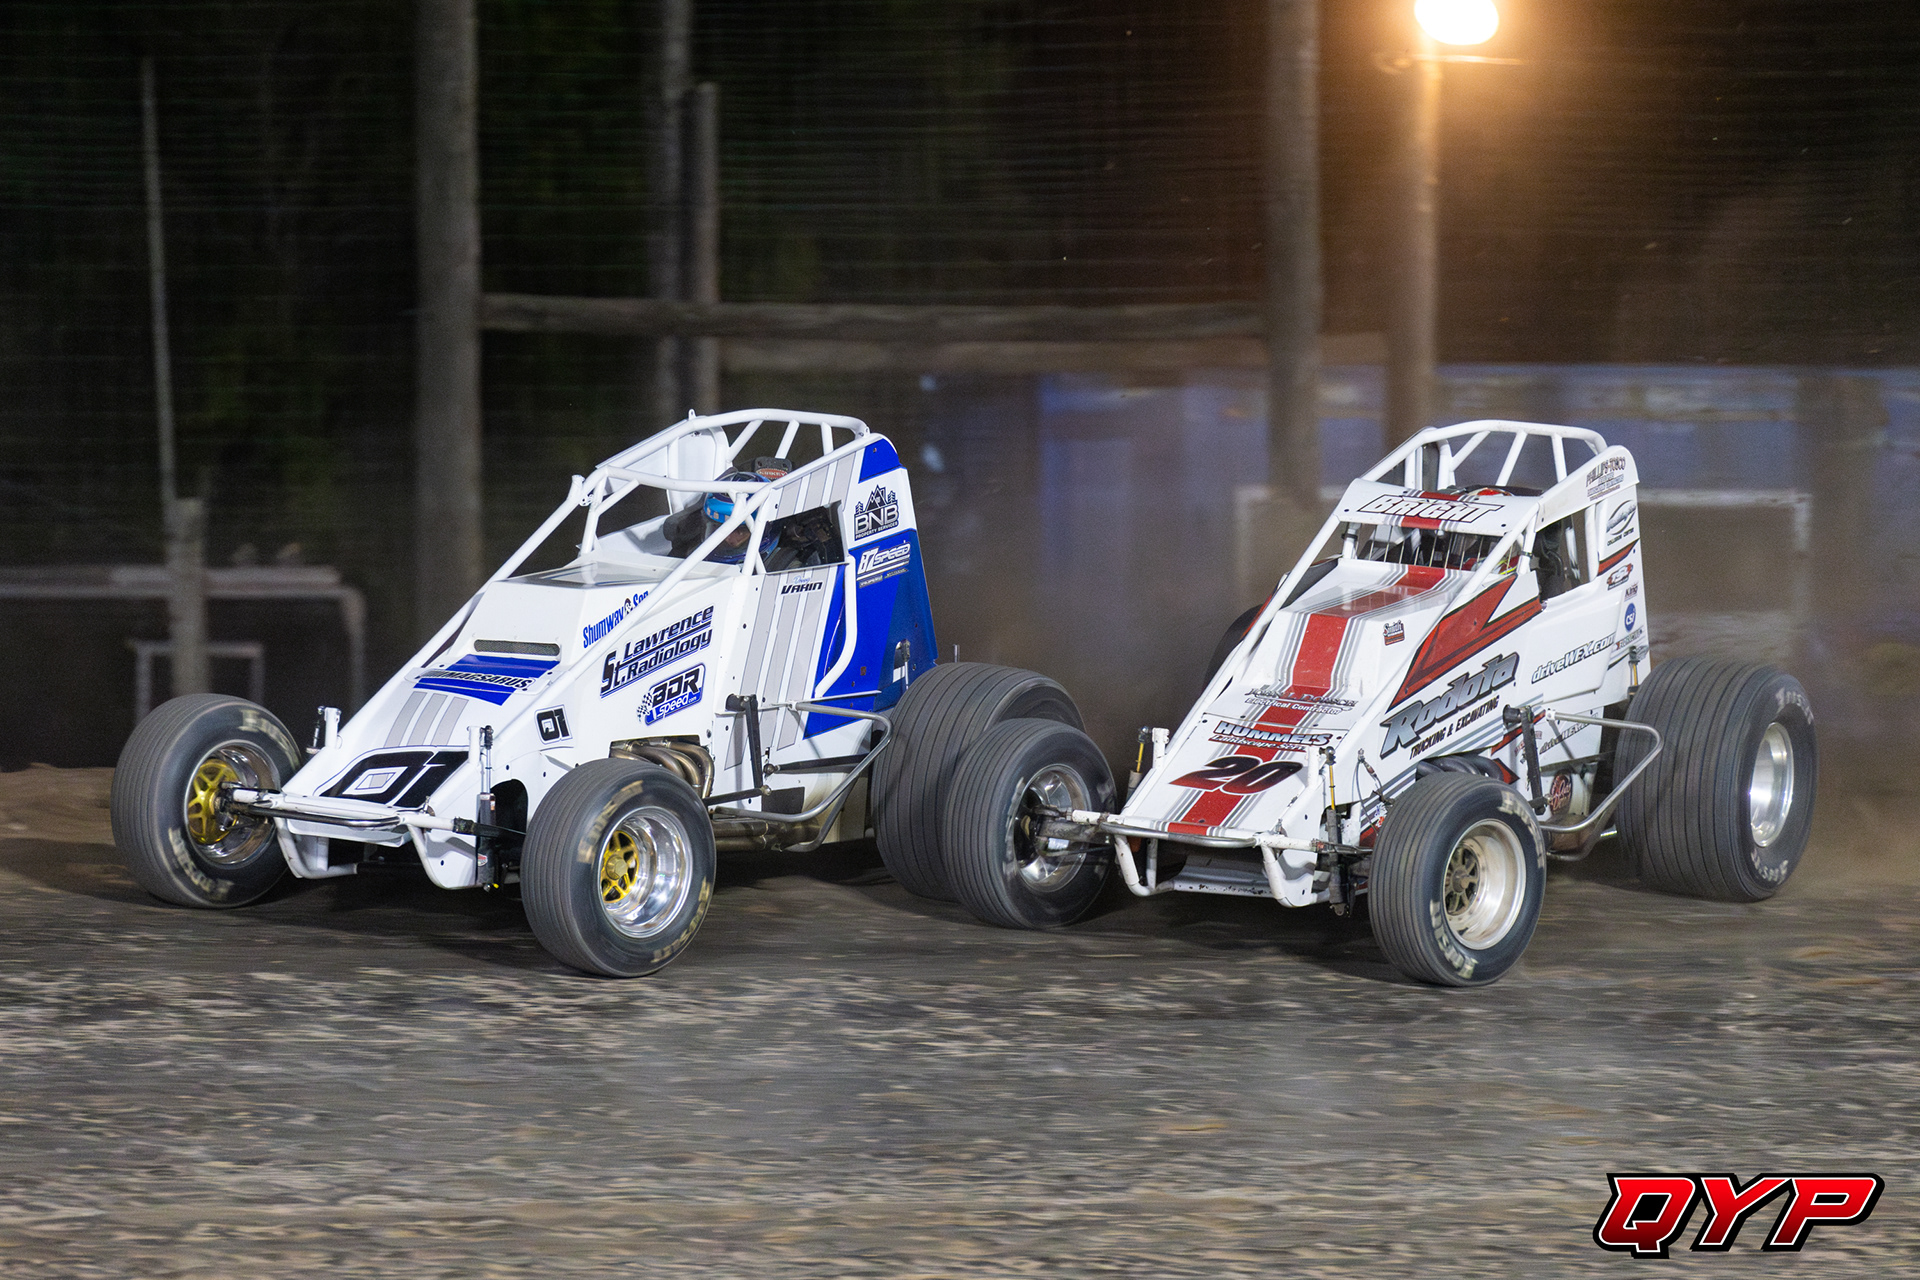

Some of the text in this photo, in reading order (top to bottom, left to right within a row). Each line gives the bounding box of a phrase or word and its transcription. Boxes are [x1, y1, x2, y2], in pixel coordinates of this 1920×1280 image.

[855, 504, 898, 536] BNB
[1357, 494, 1505, 524] BRIGHT
[856, 520, 898, 539] PROPERTY SERVICES
[874, 543, 911, 566] SPEED
[781, 581, 823, 595] VARIN
[622, 605, 714, 662] Lawrence
[626, 628, 713, 682] Radiology
[1244, 696, 1291, 709] Electrical
[1212, 720, 1333, 746] HUMMEL'S
[1409, 694, 1500, 760] TRUCKING & EXCAVATING
[1168, 755, 1304, 794] 20
